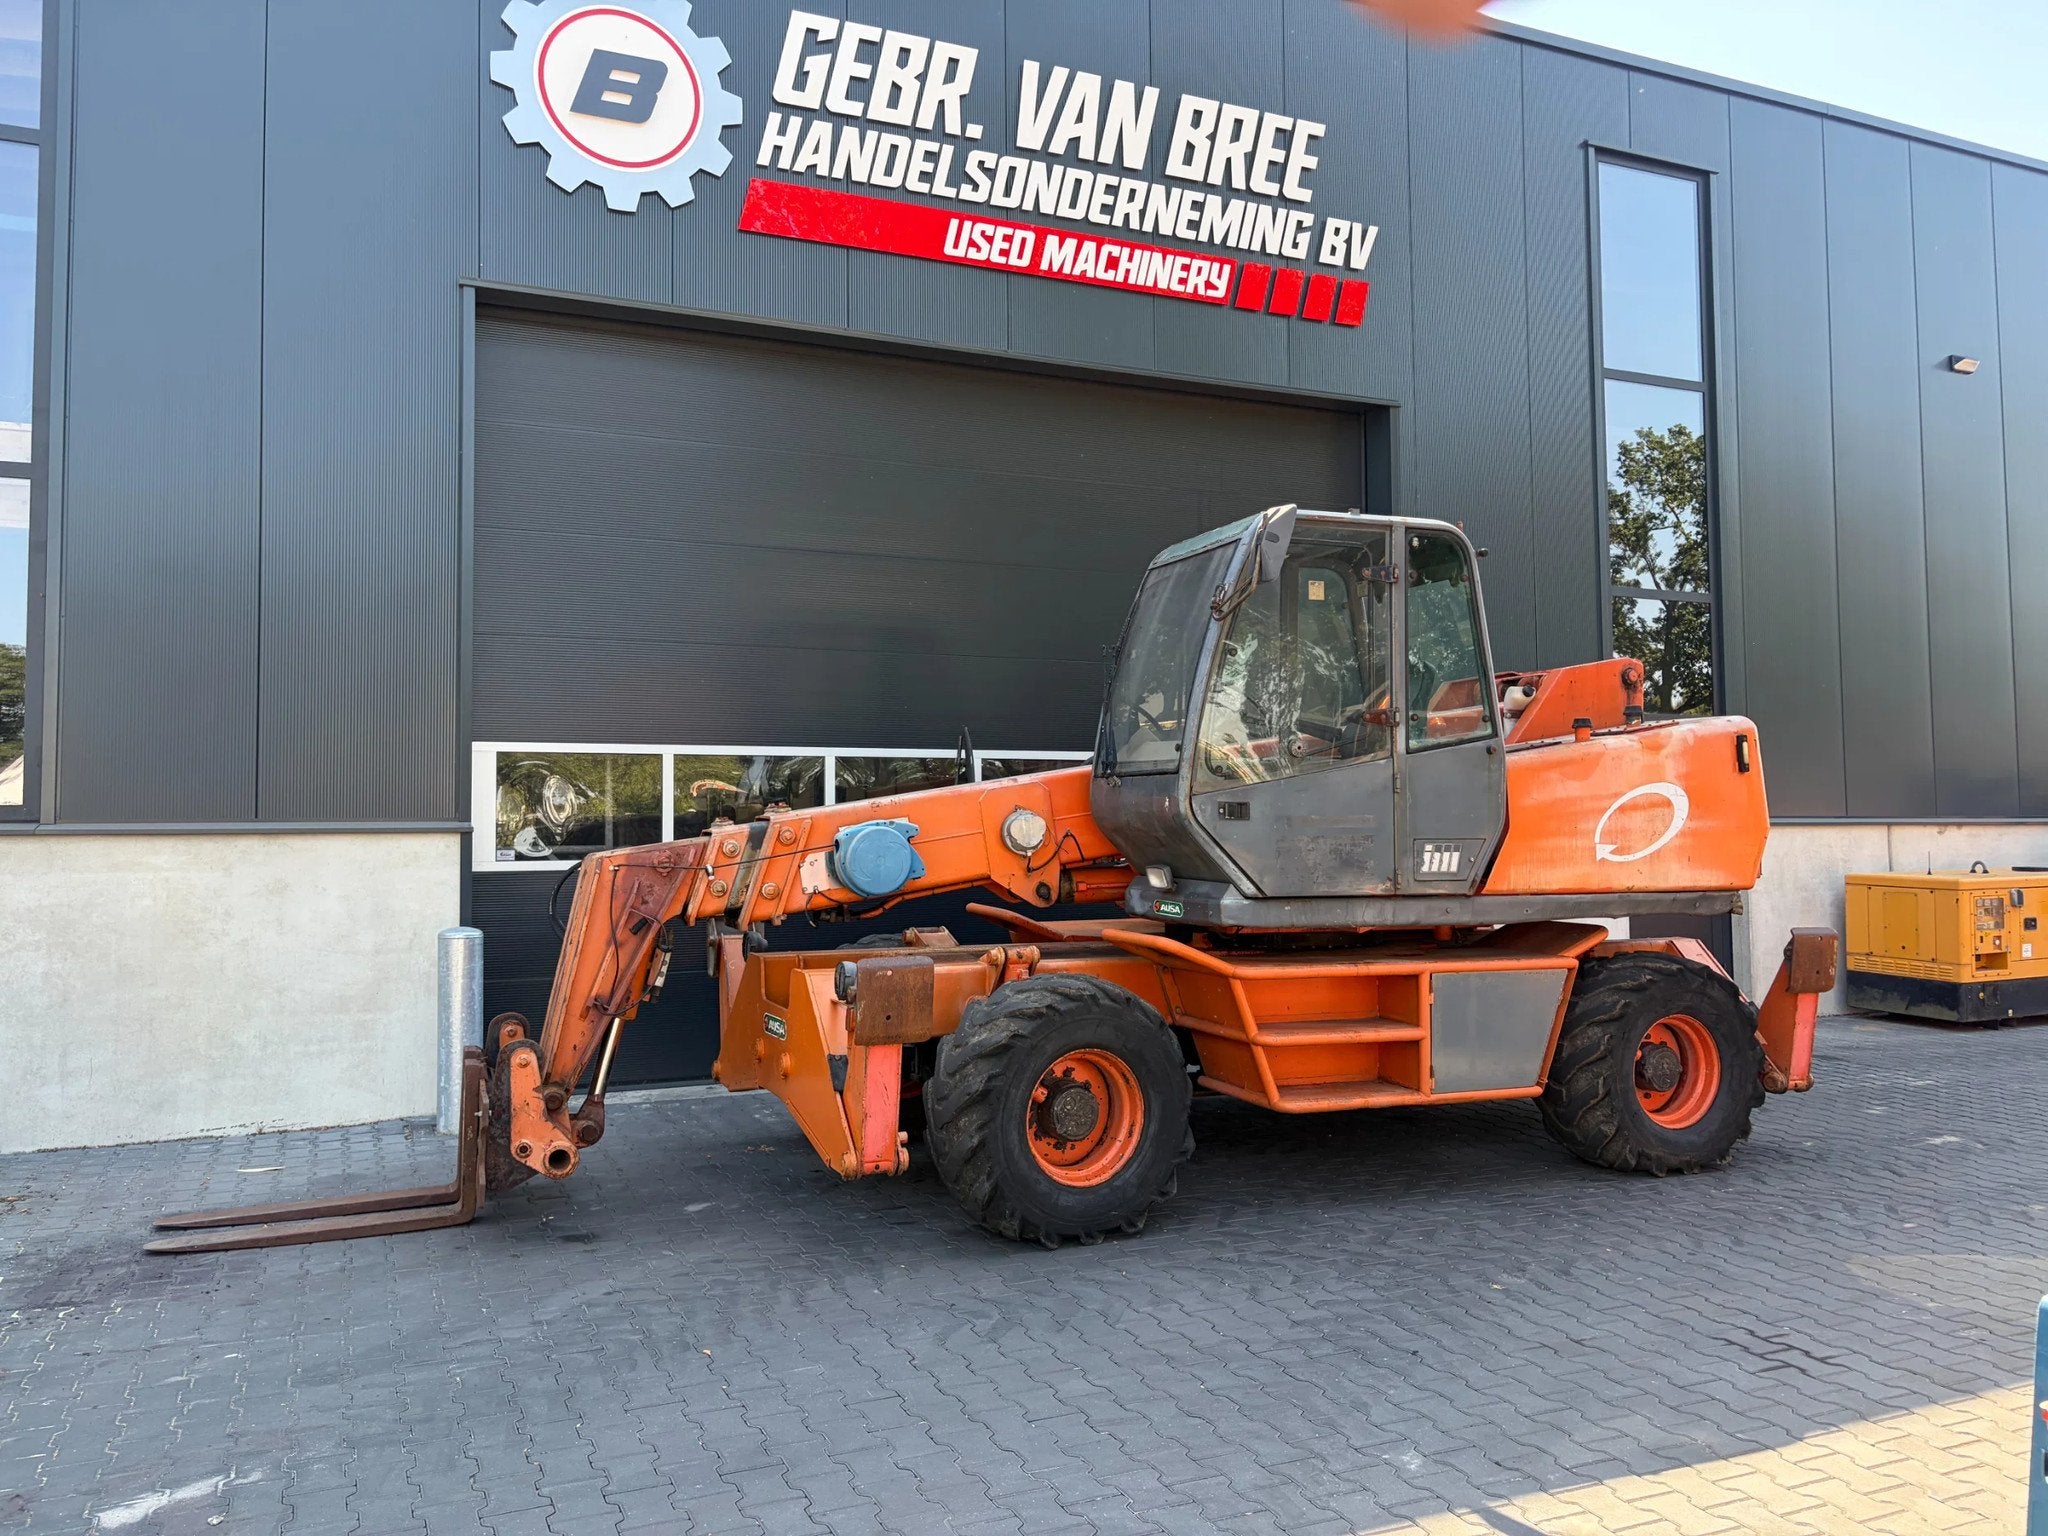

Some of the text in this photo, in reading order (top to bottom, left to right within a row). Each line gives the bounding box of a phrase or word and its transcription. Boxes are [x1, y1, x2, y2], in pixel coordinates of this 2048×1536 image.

[569, 48, 669, 124] B
[772, 10, 1326, 202] GEBR. VAN BREE
[757, 113, 1379, 270] HANDELSONDERNEMING BV
[943, 219, 1232, 298] USED MACHINERY
